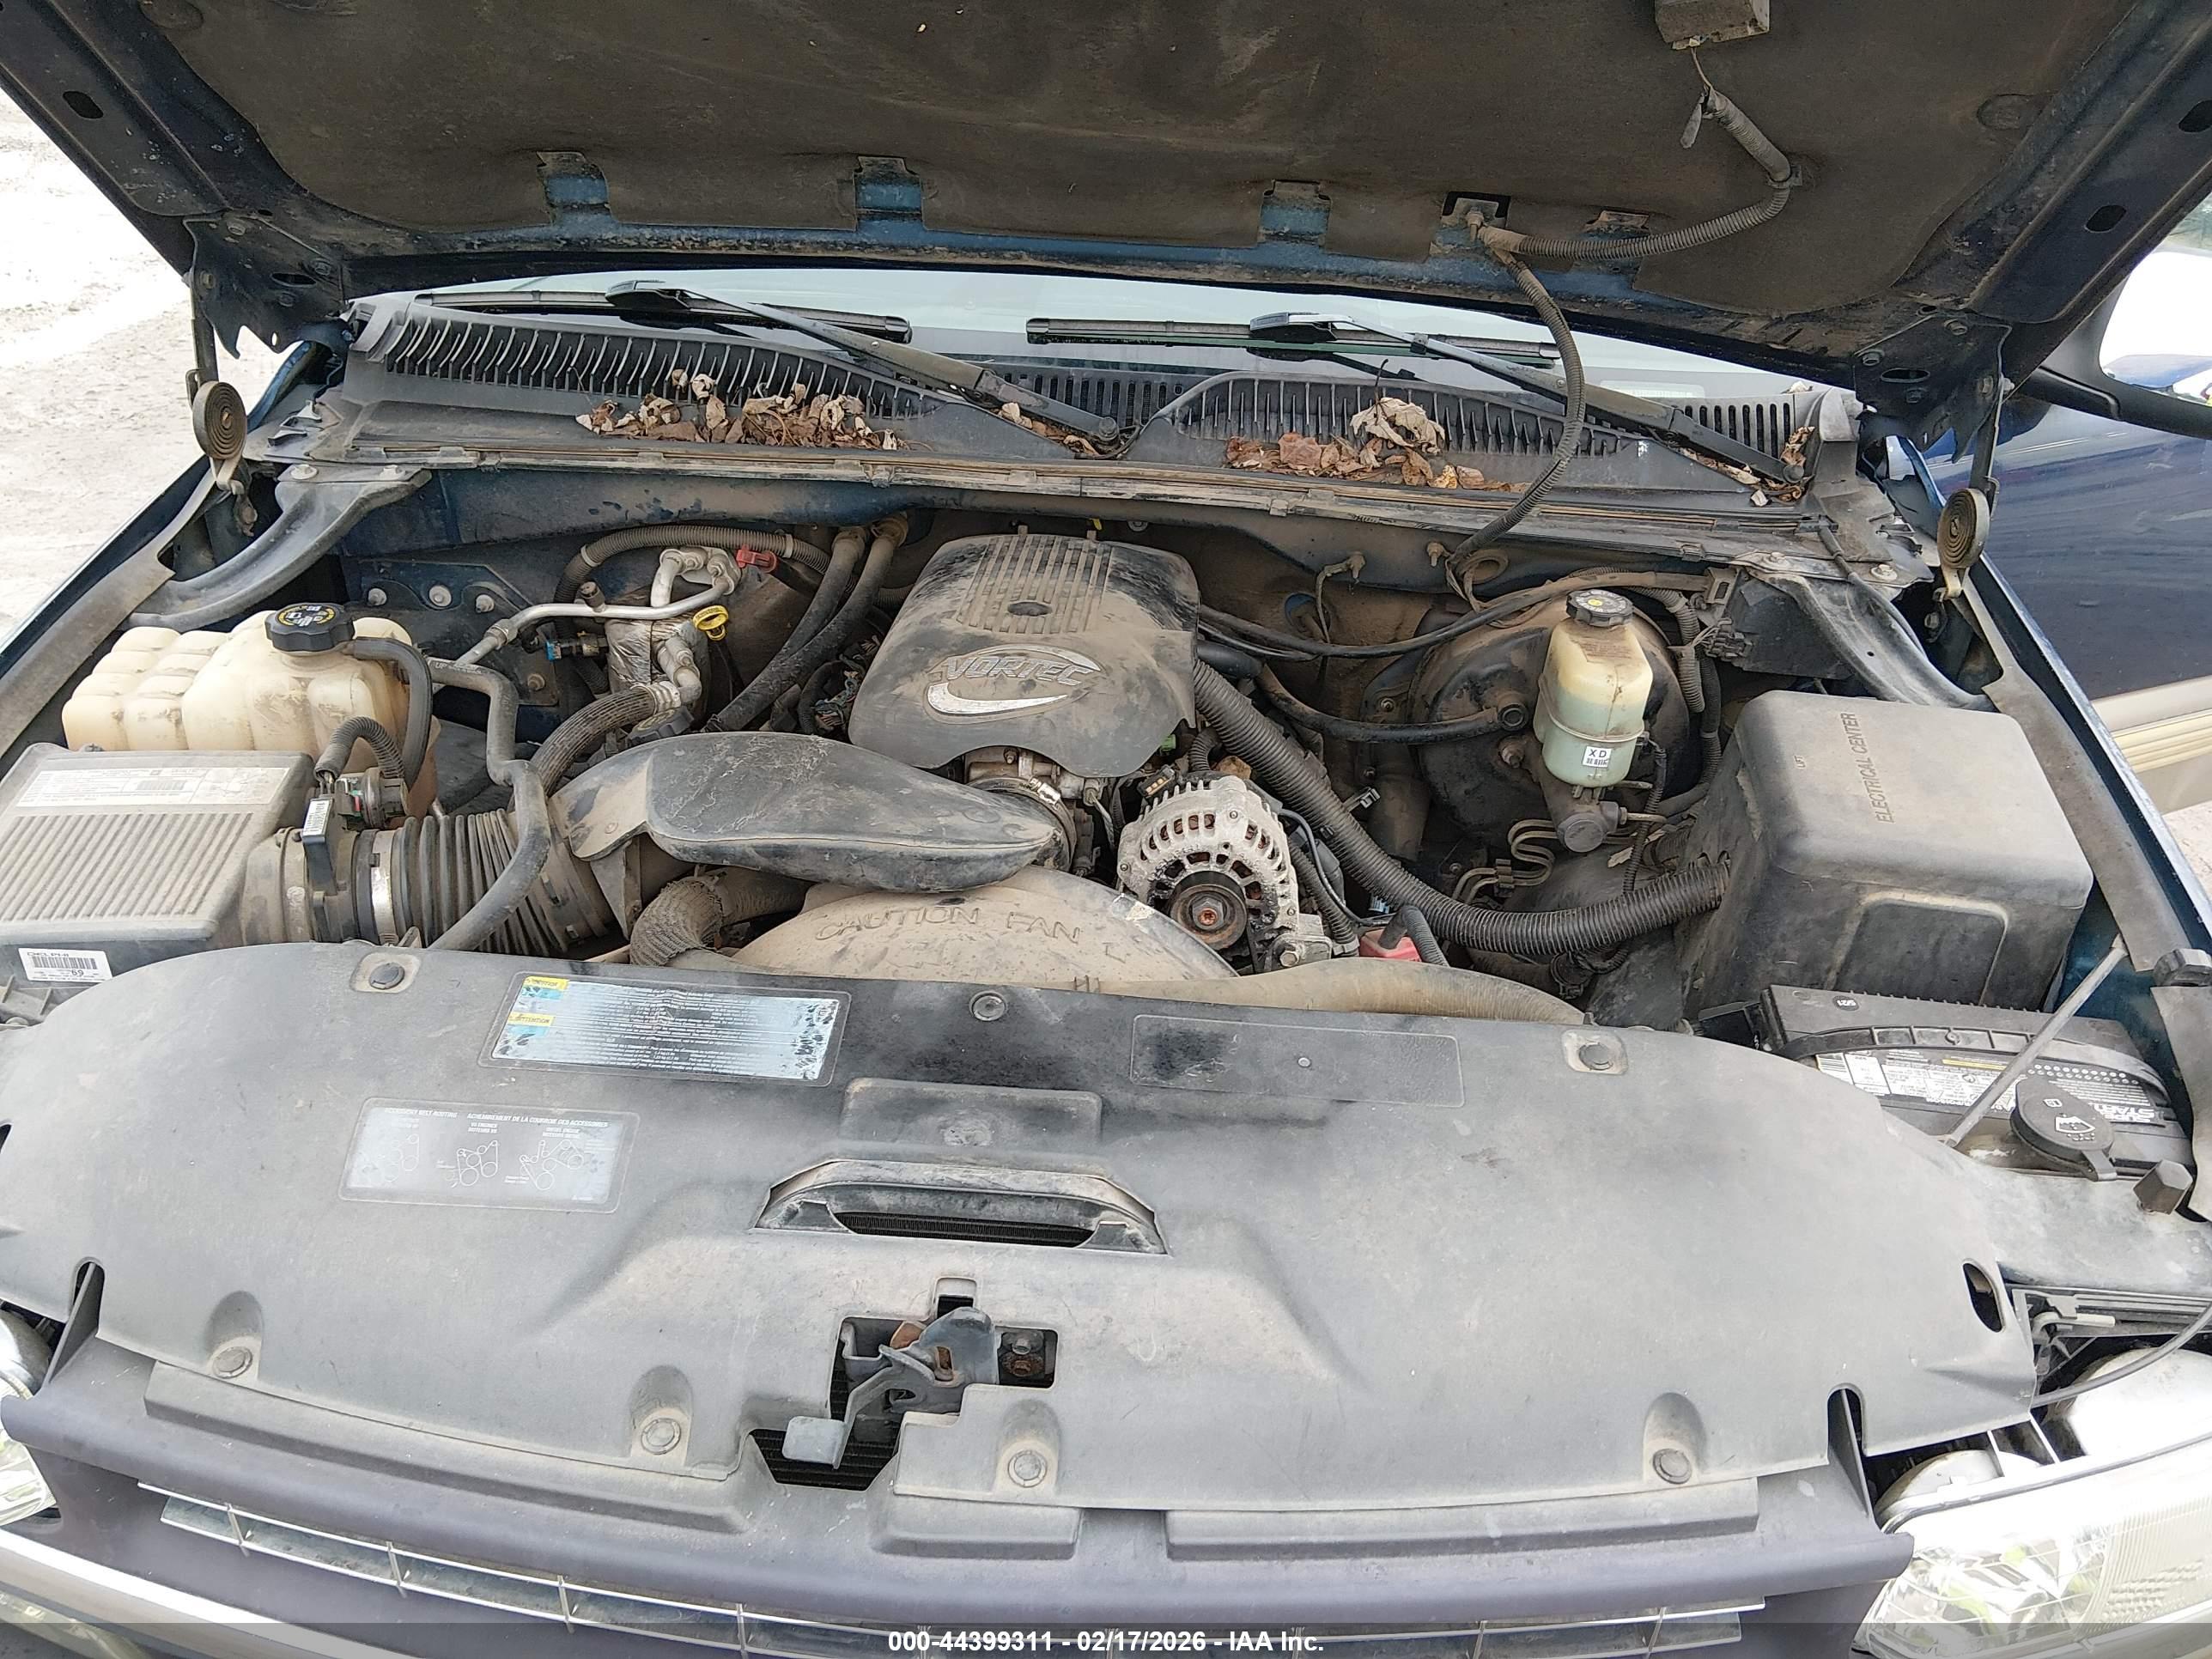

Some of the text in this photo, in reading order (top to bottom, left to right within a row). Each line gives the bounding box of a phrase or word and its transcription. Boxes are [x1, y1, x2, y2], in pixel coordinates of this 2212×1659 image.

[946, 656, 1095, 686] VORTEC
[1794, 755, 1807, 769] LIFT
[1841, 713, 1896, 823] ELECTRICAL CENTER
[815, 906, 1082, 945] CAUTION FAN
